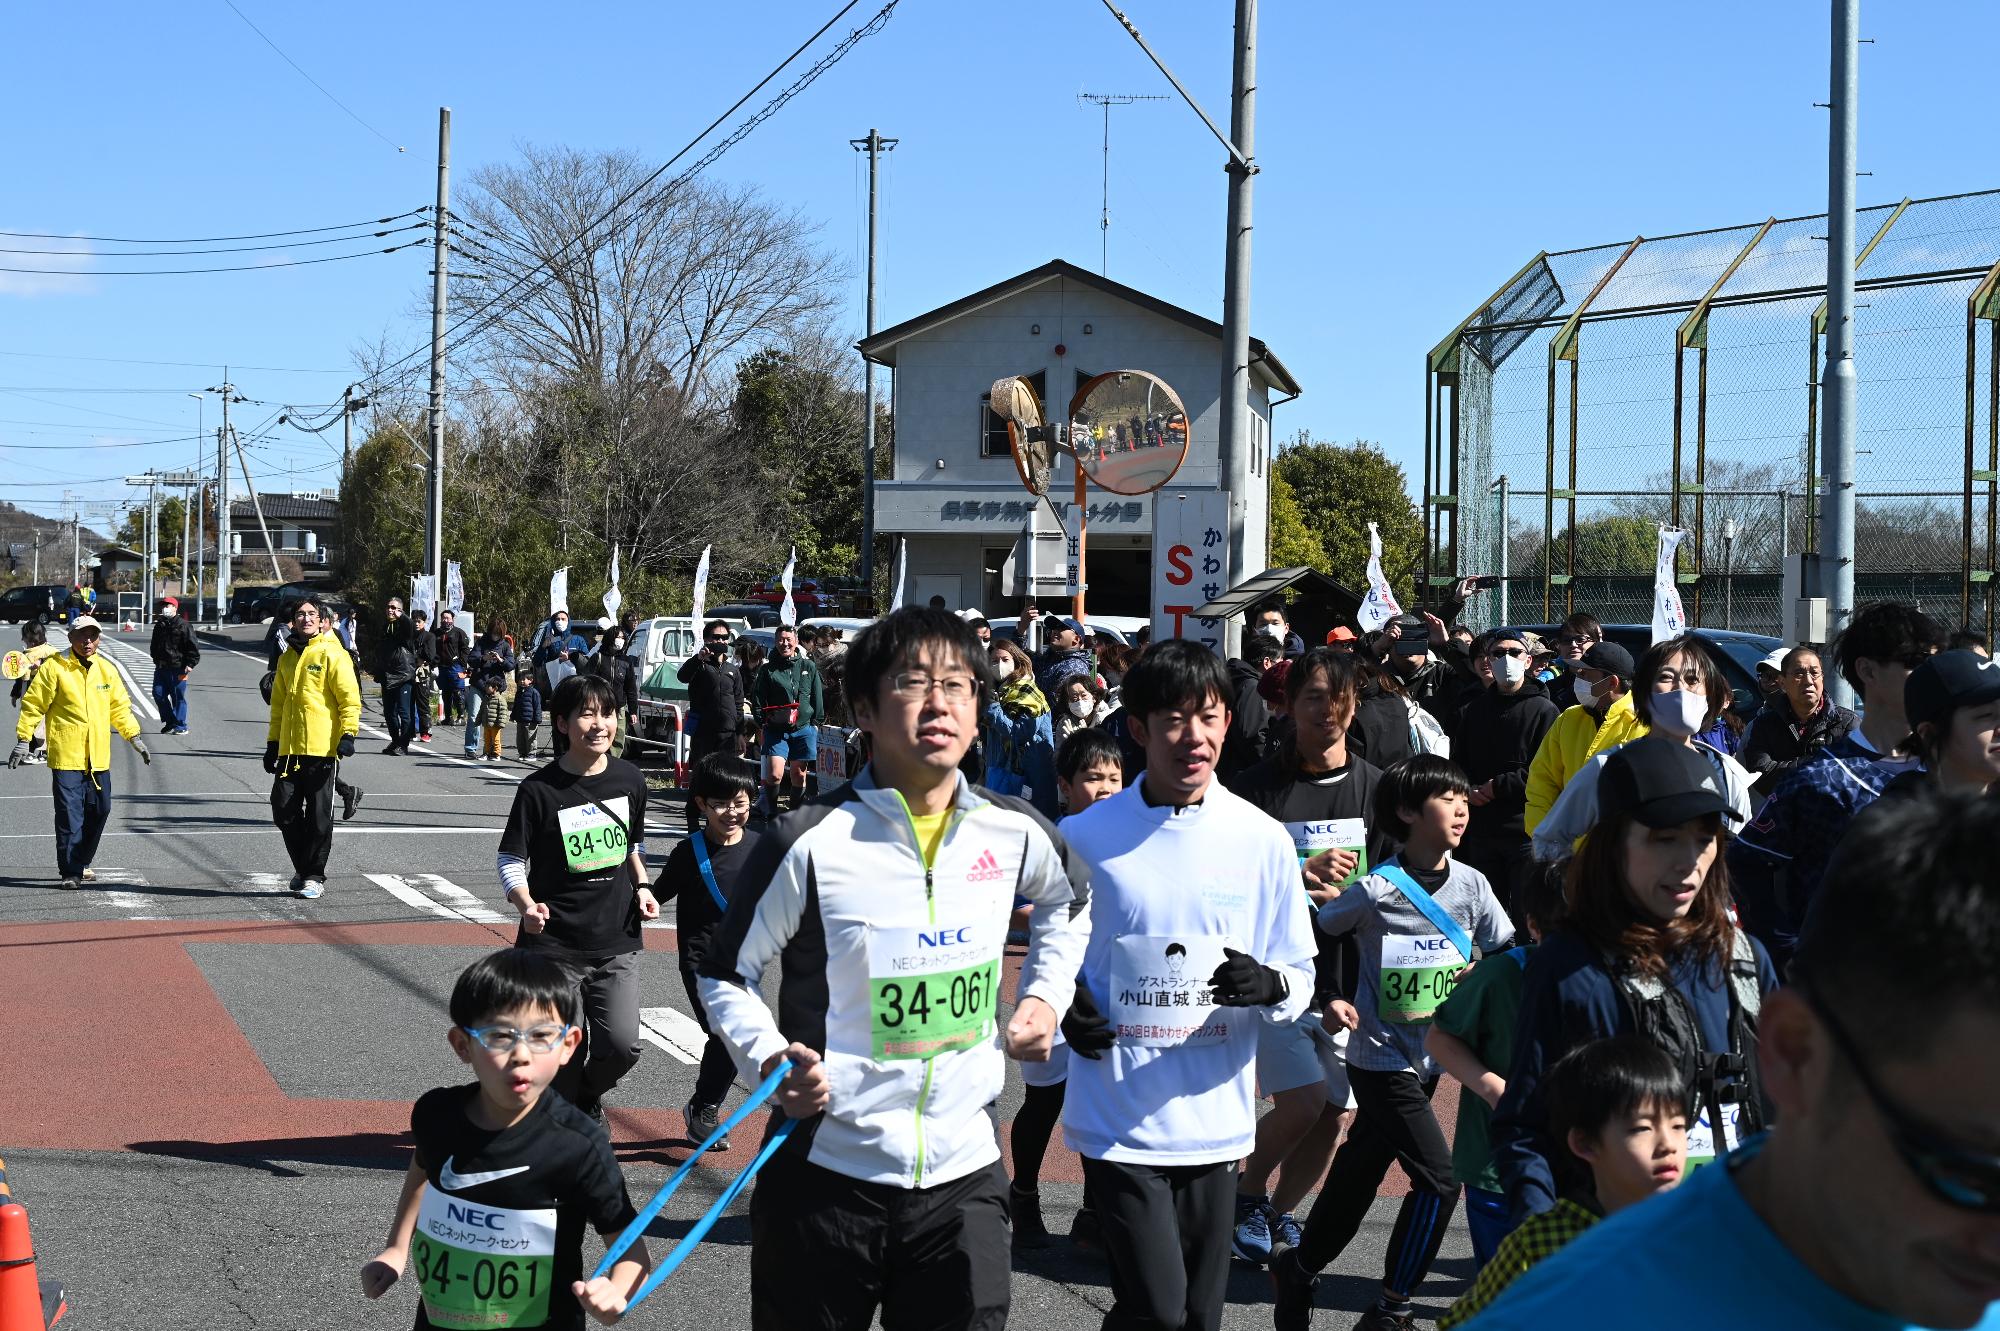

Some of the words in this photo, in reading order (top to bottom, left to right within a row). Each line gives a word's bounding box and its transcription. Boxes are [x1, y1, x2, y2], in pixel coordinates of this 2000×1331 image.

[1067, 536, 1079, 587] 注意
[1303, 823, 1338, 835] NEC
[966, 869, 1004, 882] adidas
[918, 926, 972, 949] NEC
[1414, 938, 1450, 951] NEC
[1138, 976, 1210, 988] ゲストランナー
[879, 966, 992, 1028] 34-061
[1119, 989, 1190, 1007] 小山直城
[1116, 1023, 1227, 1039] 第50回日高かわせみマラソン大会
[448, 1203, 505, 1230] NEC
[429, 1218, 530, 1250] NECネットワーク・センサ
[416, 1240, 537, 1300] 34-061
